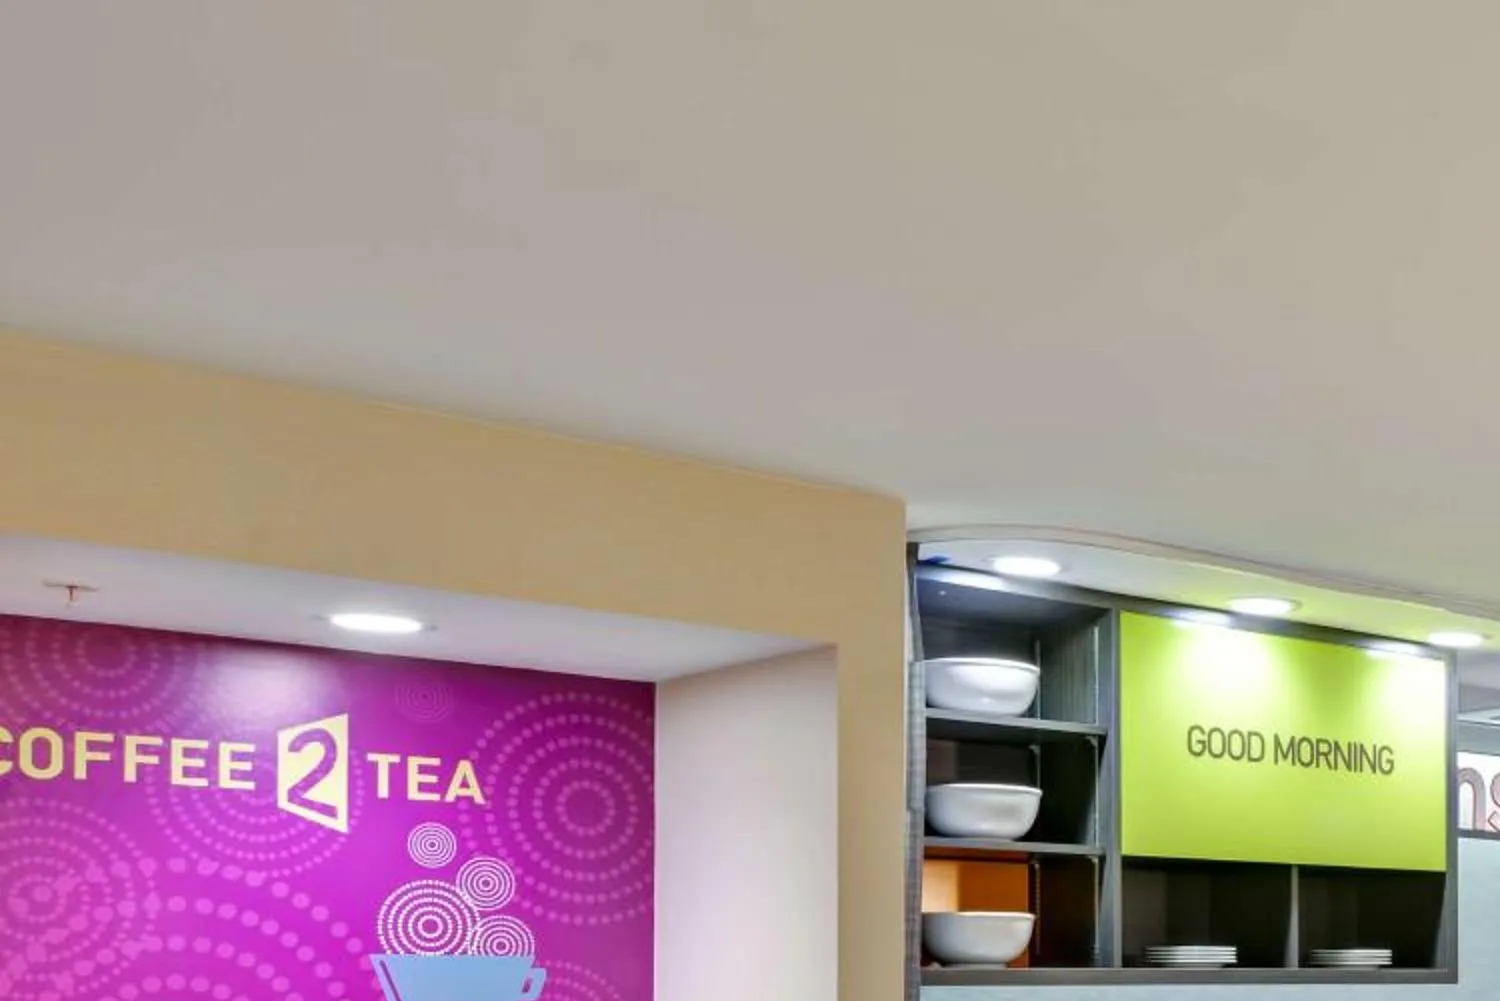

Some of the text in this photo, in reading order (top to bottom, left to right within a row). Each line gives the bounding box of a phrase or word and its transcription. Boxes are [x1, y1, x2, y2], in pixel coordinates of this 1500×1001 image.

[287, 728, 338, 820] 2
[366, 752, 487, 805] TEA
[1186, 724, 1396, 776] GOOD MORNING
